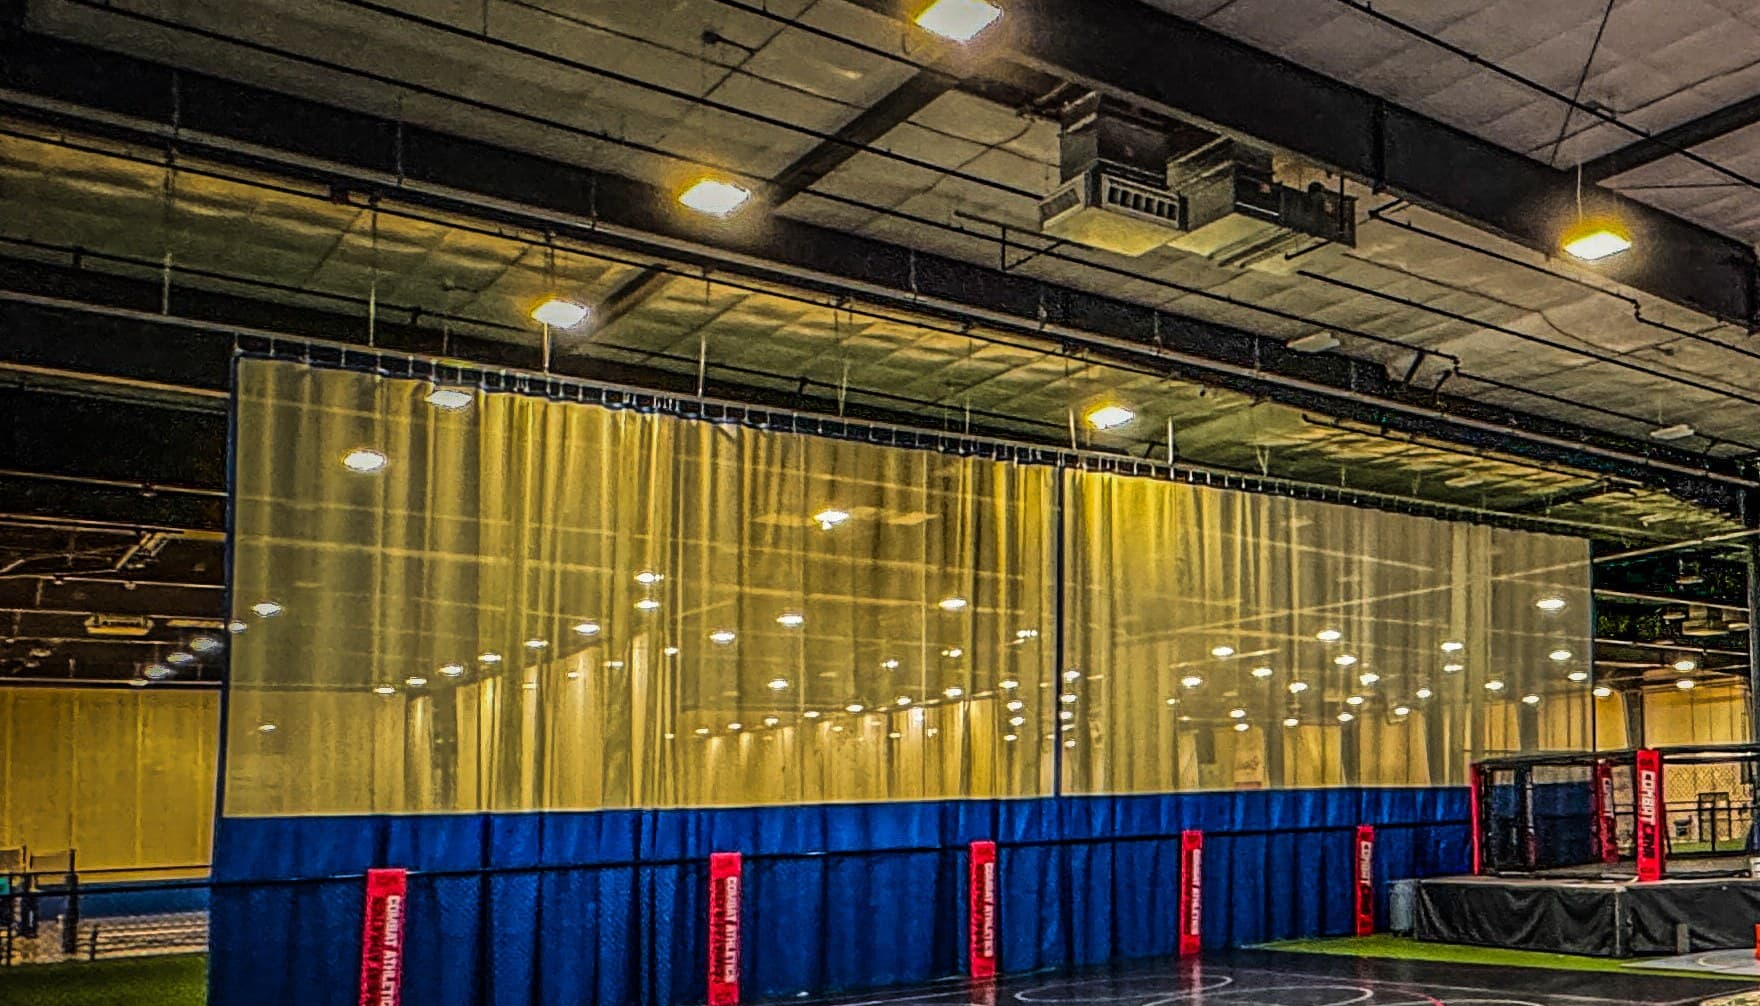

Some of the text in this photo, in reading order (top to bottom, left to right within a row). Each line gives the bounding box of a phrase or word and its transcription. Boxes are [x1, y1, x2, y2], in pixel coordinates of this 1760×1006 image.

[1641, 769, 1656, 825] COMBAT
[1360, 840, 1373, 886] COMBAT
[383, 895, 401, 947] COMBAT
[724, 876, 738, 983] COMBAT ATHLETICS
[983, 862, 995, 957] COMBAT ATHLETICS
